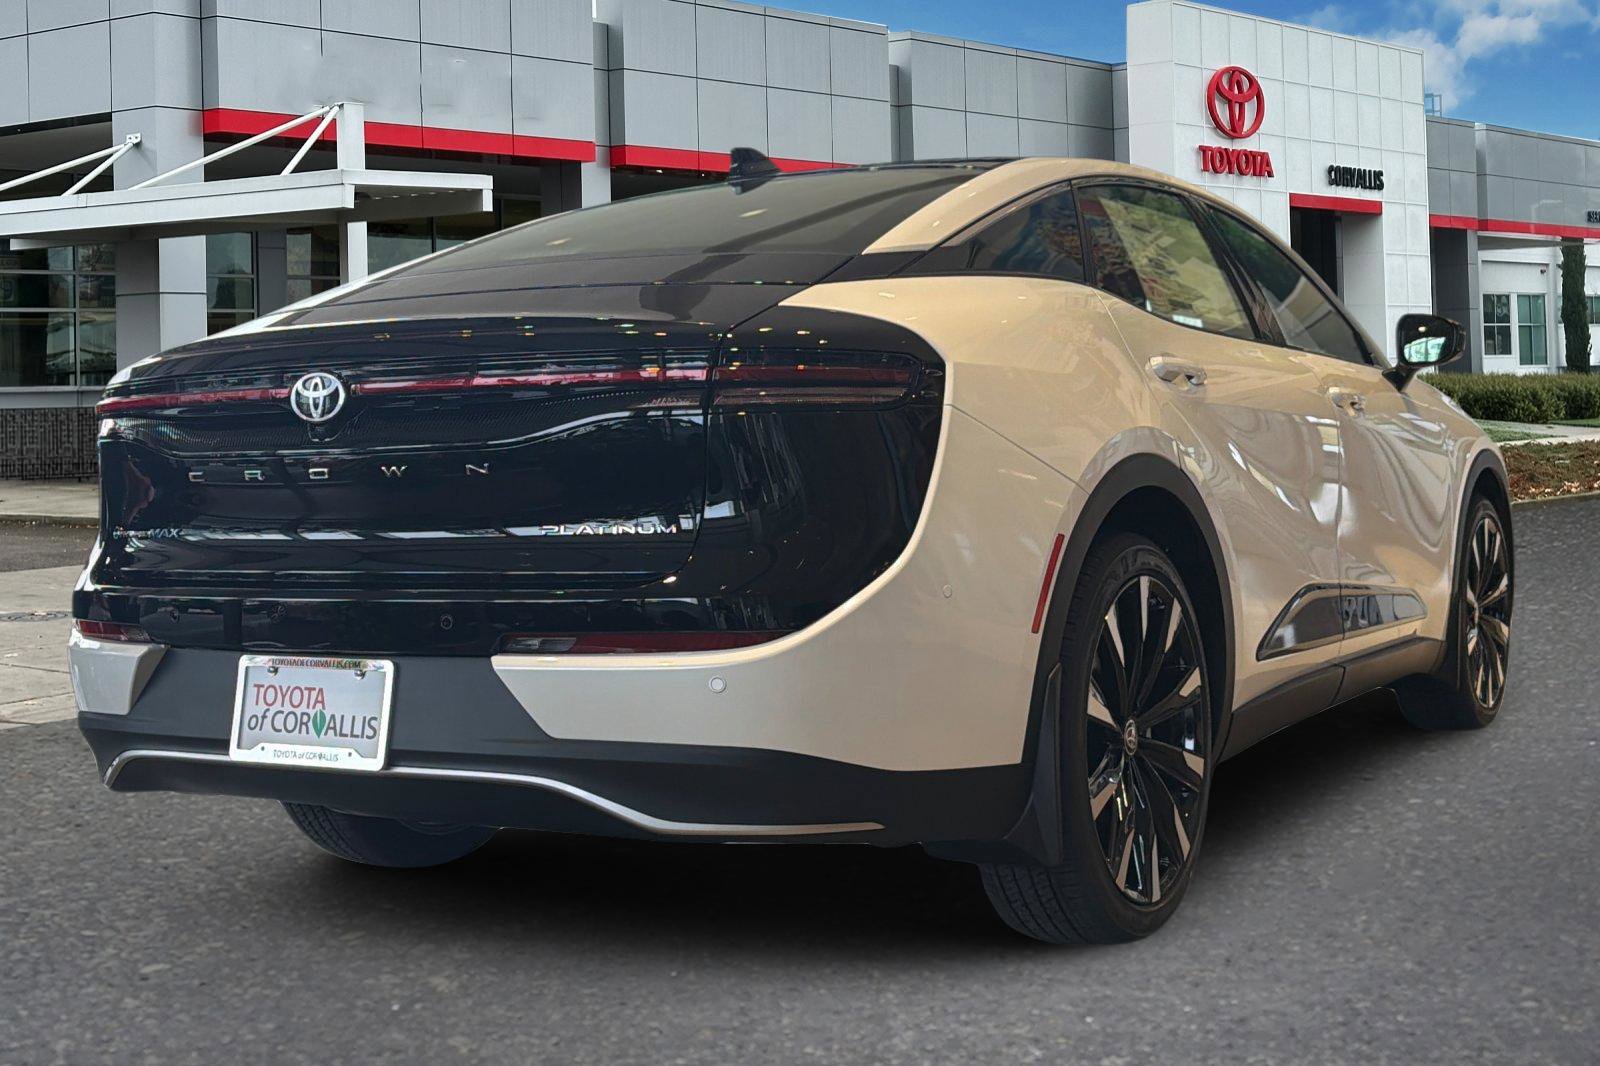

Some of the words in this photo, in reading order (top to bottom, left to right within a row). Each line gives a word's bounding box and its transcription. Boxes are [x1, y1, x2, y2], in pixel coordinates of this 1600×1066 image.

[1199, 145, 1274, 178] TOYOTA
[1328, 164, 1385, 191] CORVALLIS
[188, 462, 490, 482] CROWN
[540, 523, 678, 536] PLATINUM
[253, 683, 326, 710] TOYOTA
[247, 708, 270, 732] of
